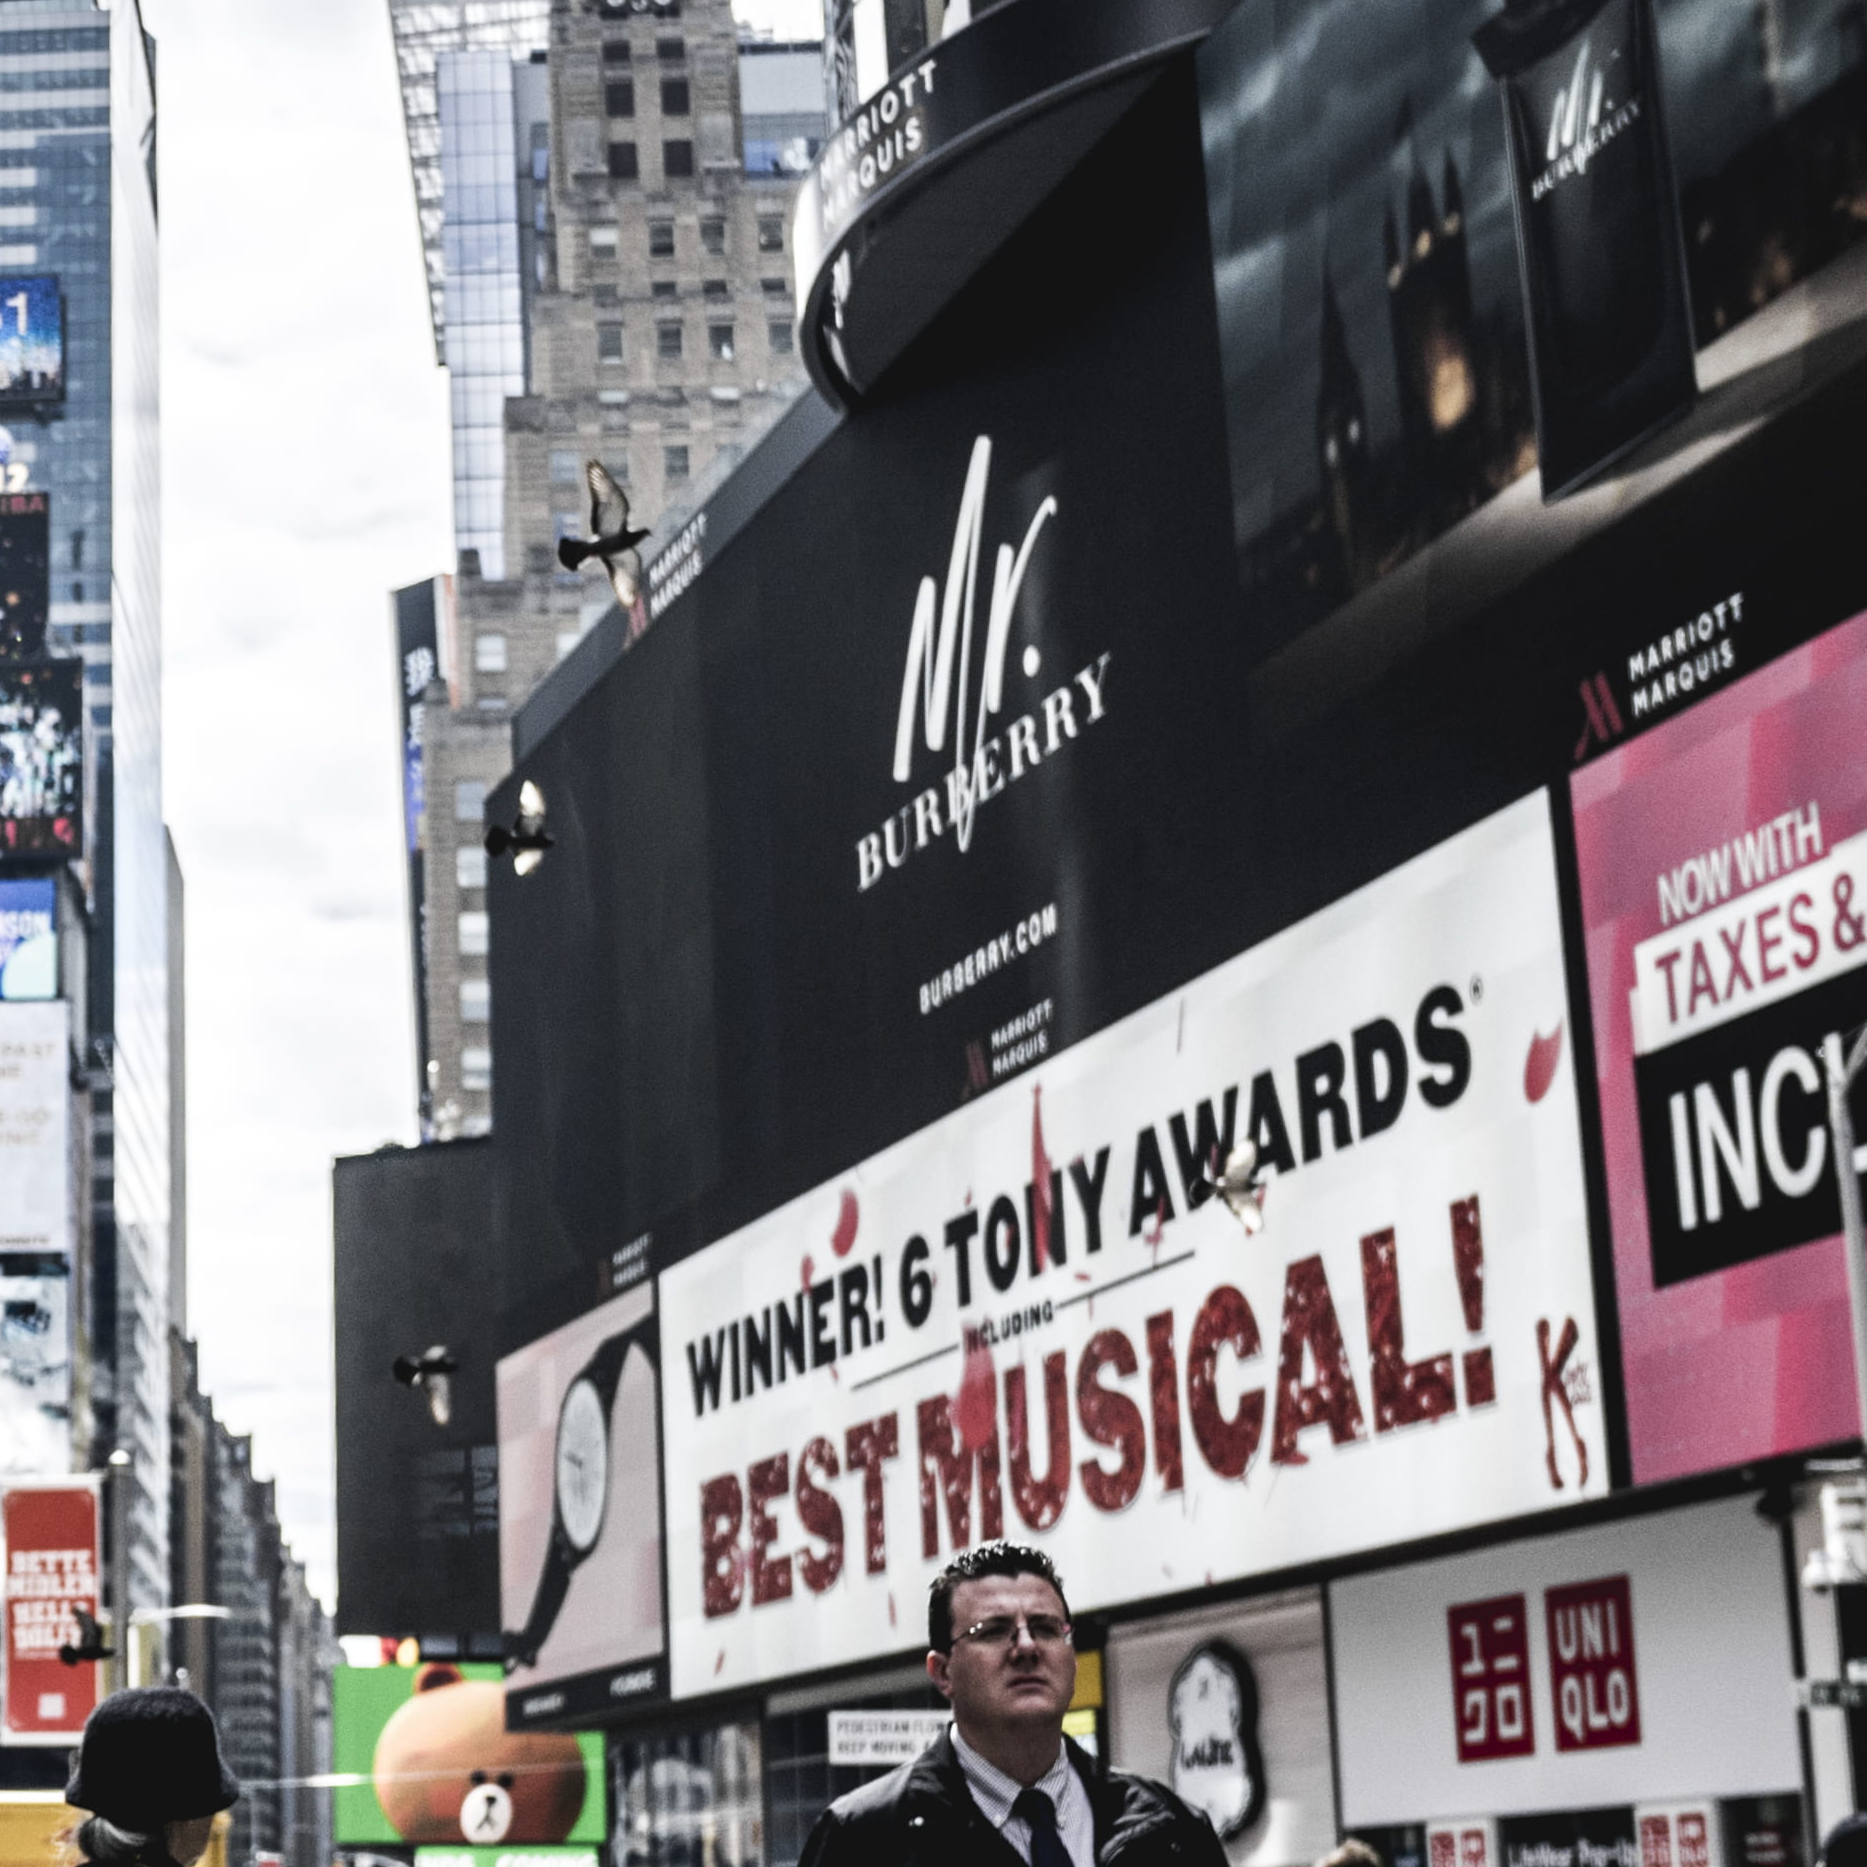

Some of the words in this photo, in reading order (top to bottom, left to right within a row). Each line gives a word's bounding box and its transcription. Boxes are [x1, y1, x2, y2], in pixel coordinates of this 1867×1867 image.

[1628, 592, 1745, 682] MARRIOTT
[1632, 640, 1737, 720] MARQUIS
[854, 652, 1113, 893] BURBERRY
[1657, 842, 1731, 927] NOW
[1731, 800, 1824, 894] WITH
[919, 902, 1059, 1015] BURBERRY.COM
[1654, 888, 1820, 1027] TAXES
[1832, 873, 1867, 957] &
[991, 999, 1055, 1053] MARRIOTT
[992, 1032, 1048, 1078] MARQUIS
[686, 1252, 886, 1419] WINNER!
[900, 1234, 935, 1332] 6
[944, 1144, 1113, 1311] TONY
[699, 1411, 900, 1620] BEST
[917, 1192, 1498, 1561] MUSICAL!
[1555, 1597, 1621, 1664] UNI
[1561, 1668, 1631, 1745] QLO
